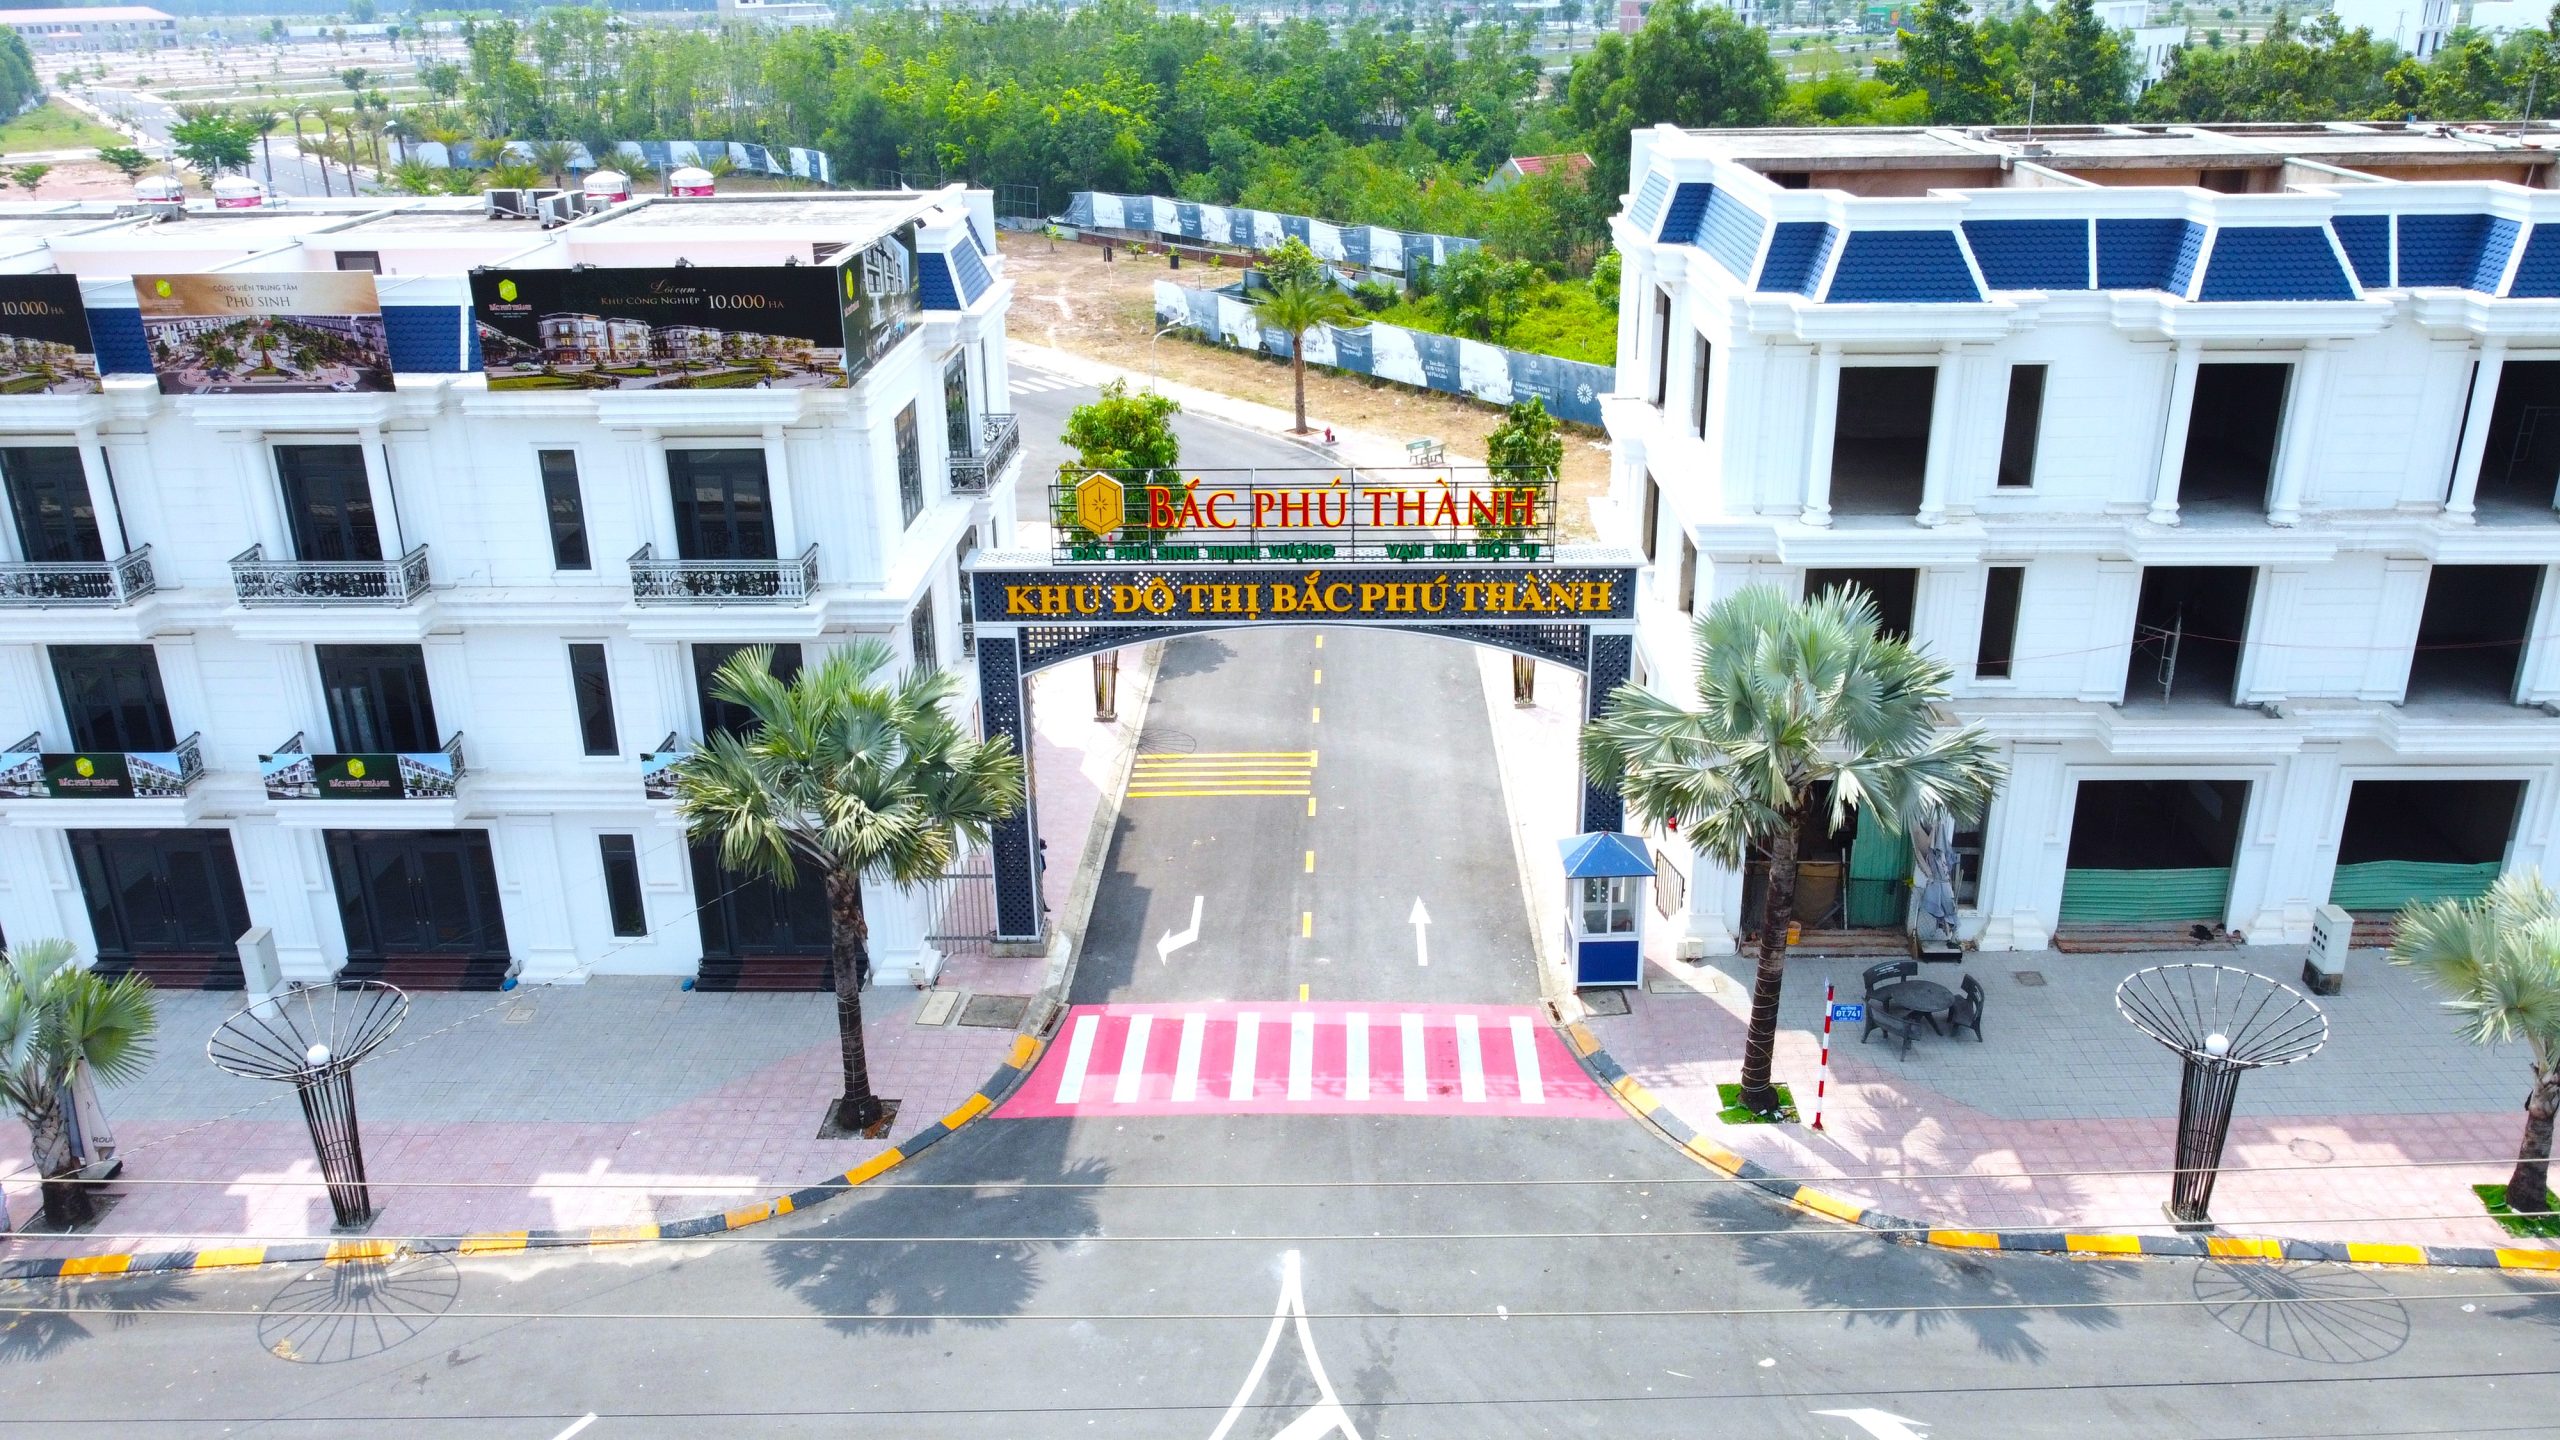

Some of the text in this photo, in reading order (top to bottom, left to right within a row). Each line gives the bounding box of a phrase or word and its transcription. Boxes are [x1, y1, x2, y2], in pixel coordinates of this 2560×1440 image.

[213, 284, 236, 292] CÔNG
[238, 284, 254, 292] VIÊN
[2, 301, 65, 316] 10.000 HA
[226, 294, 291, 308] PHÚ SINH
[601, 297, 623, 305] KHU
[626, 296, 658, 305] CÔNG
[708, 294, 766, 309] 10.000
[768, 300, 784, 309] HA
[1145, 475, 1537, 529] BẮC PHÚ THÀNH
[1114, 540, 1151, 561] PHÚ
[1156, 544, 1199, 561] SINH
[1206, 544, 1260, 563] THỊNH
[1268, 542, 1335, 563] VƯỢNG
[1385, 540, 1540, 563] VẠN KIM HỘI TỤ
[1004, 570, 1613, 620] KHU ĐÔ THỊ BẮC PHÚ THÀNH
